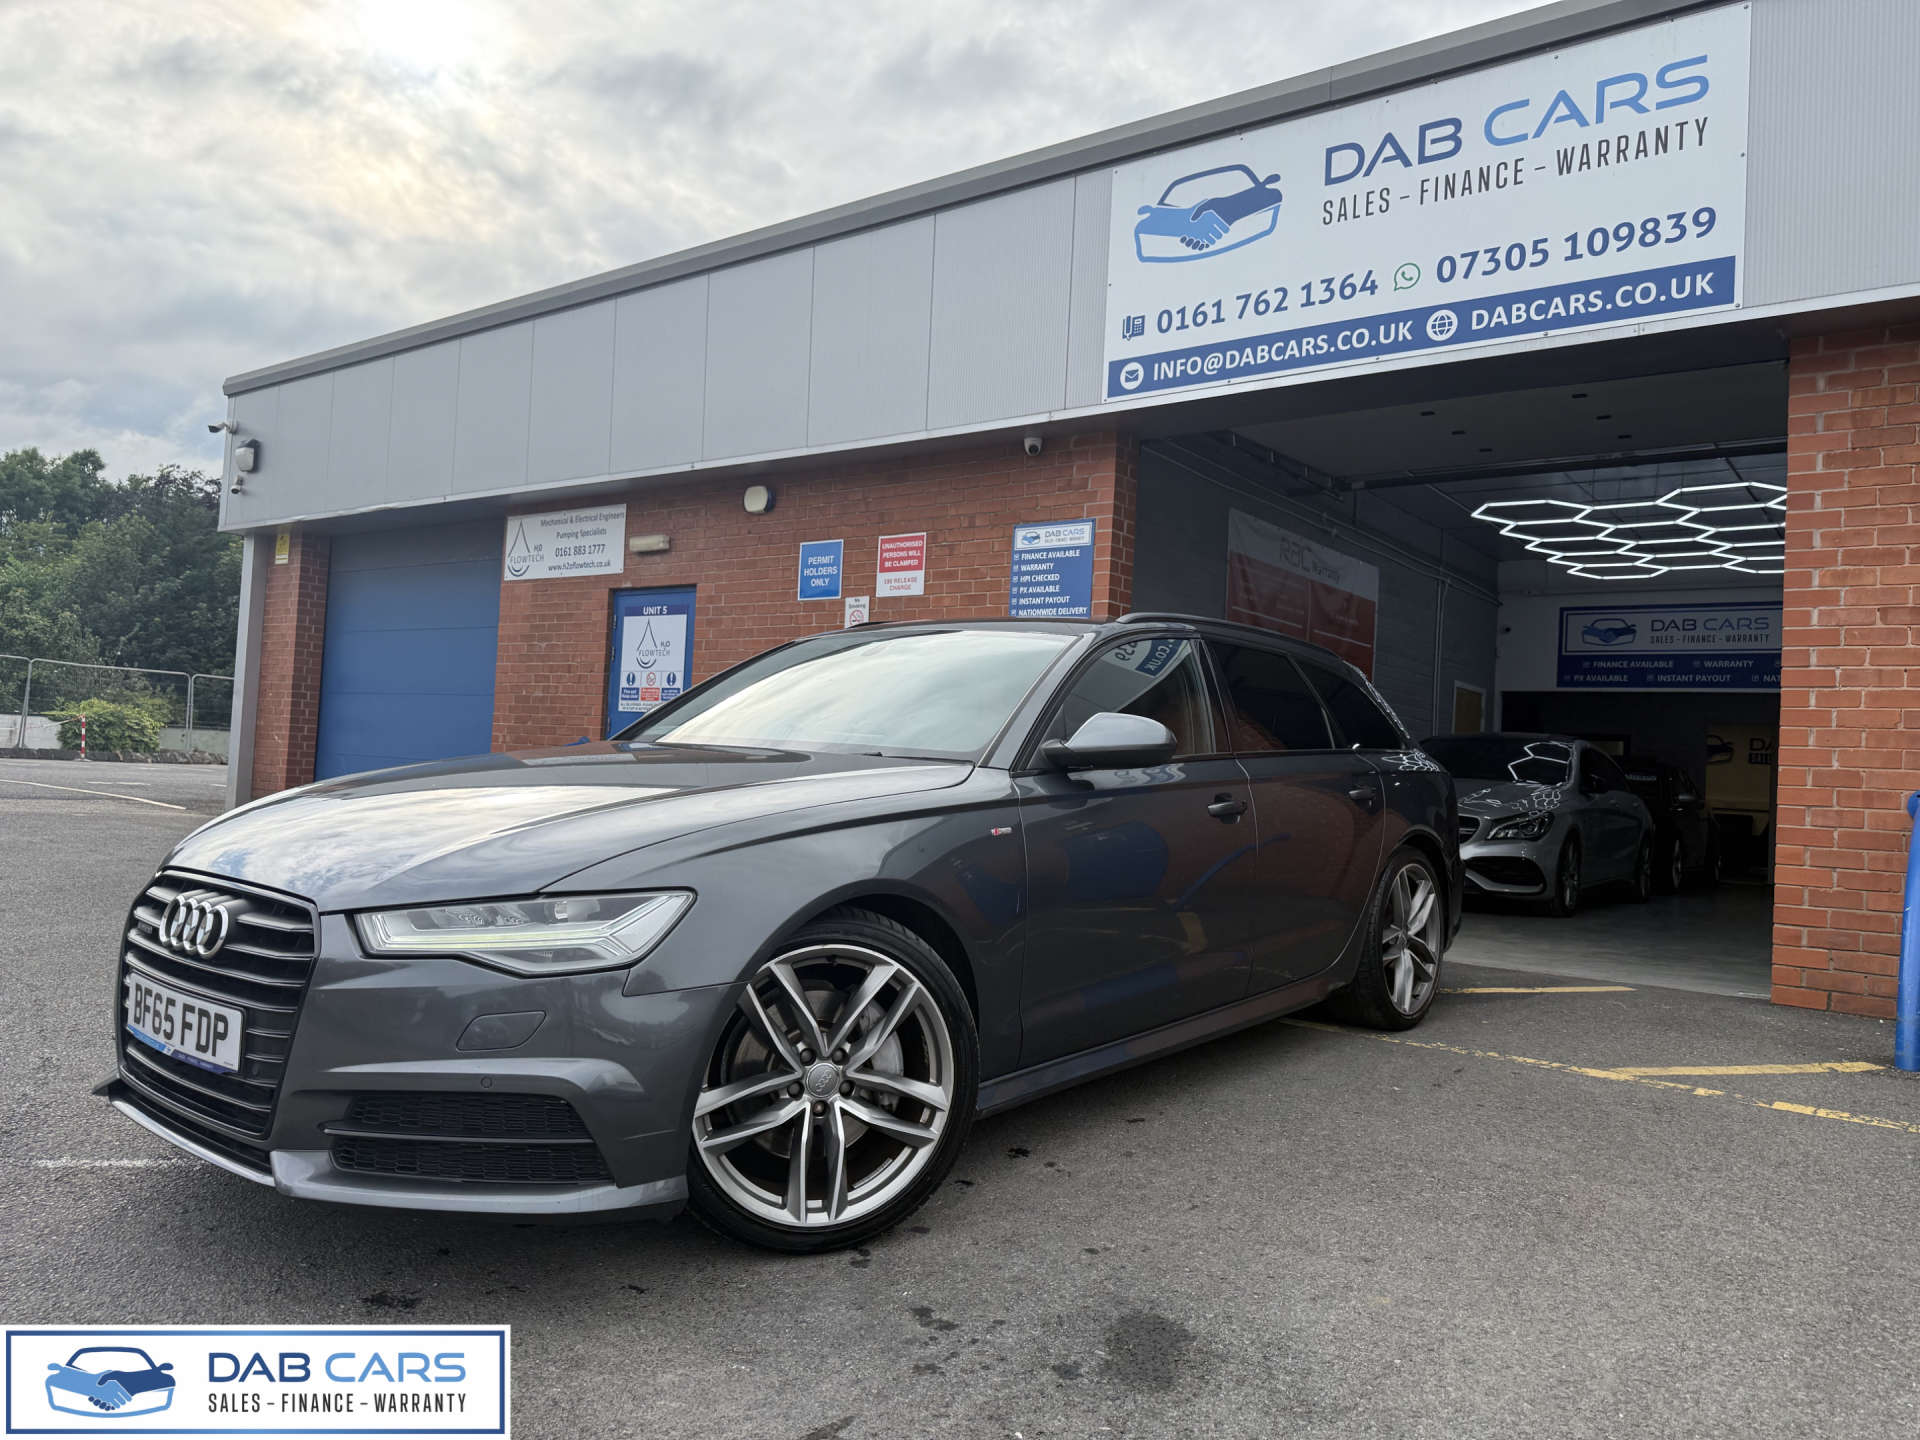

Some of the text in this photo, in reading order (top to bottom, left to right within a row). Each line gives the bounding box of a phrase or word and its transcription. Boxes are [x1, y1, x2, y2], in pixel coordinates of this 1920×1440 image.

[1324, 54, 1710, 187] DAB CARS
[1322, 187, 1390, 226] SALES
[1419, 158, 1525, 206] FINANCE
[1555, 117, 1709, 177] WARRANTY
[1156, 205, 1717, 335] 0161 762 1364 07305 109839
[1152, 272, 1714, 382] INFO@DABCARS.CO.UK DABCARS.CO.UK
[556, 528, 607, 540] Pumping Specialists
[882, 540, 923, 549] UNAUTHORISED
[555, 544, 606, 558] 0161 883 1777
[1021, 550, 1080, 560] FINANCE AVAILABLE
[808, 555, 835, 565] PERMIT
[893, 559, 918, 567] CLAMPED
[804, 566, 838, 577] HOLDERS
[1021, 563, 1054, 571] WARRANTY
[810, 578, 830, 587] ONLY
[1032, 574, 1060, 582] CHECKED
[1028, 585, 1060, 593] AVAILABLE
[1019, 596, 1070, 605] INSTANT PAYOUT
[643, 606, 668, 615] UNIT 5
[1018, 607, 1088, 616] NATIONWIDE DELIVERY
[1651, 616, 1769, 632] DAB CARS
[1650, 635, 1674, 644] SALES
[1682, 634, 1716, 644] FINANCE
[1725, 633, 1769, 644] WARRANTY
[1703, 660, 1754, 668] WARRANTY
[1657, 674, 1694, 682] INSTANT
[1695, 674, 1731, 682] PAYOUT
[133, 983, 176, 1041] BF65
[180, 1002, 229, 1057] FDP
